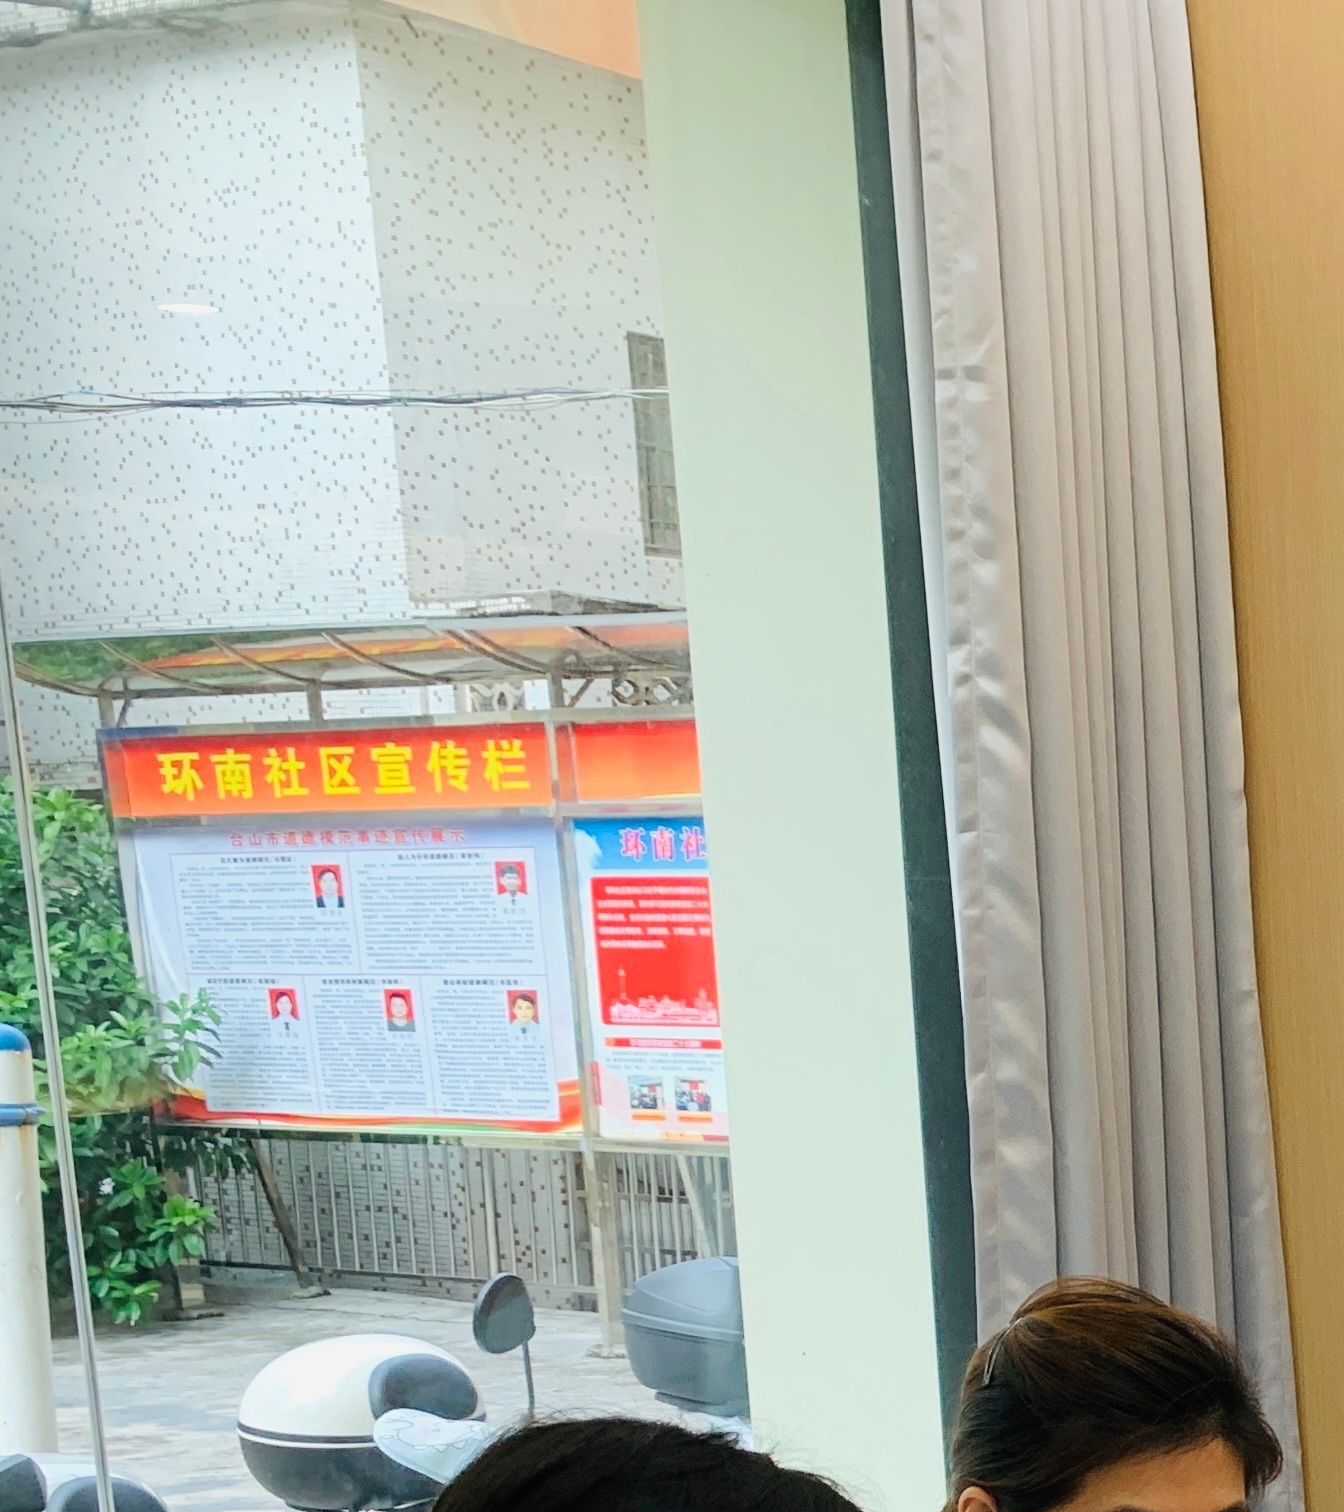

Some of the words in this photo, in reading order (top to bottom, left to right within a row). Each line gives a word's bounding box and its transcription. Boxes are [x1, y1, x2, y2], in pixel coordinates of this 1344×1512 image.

[156, 738, 532, 801] 环南社区宣传栏
